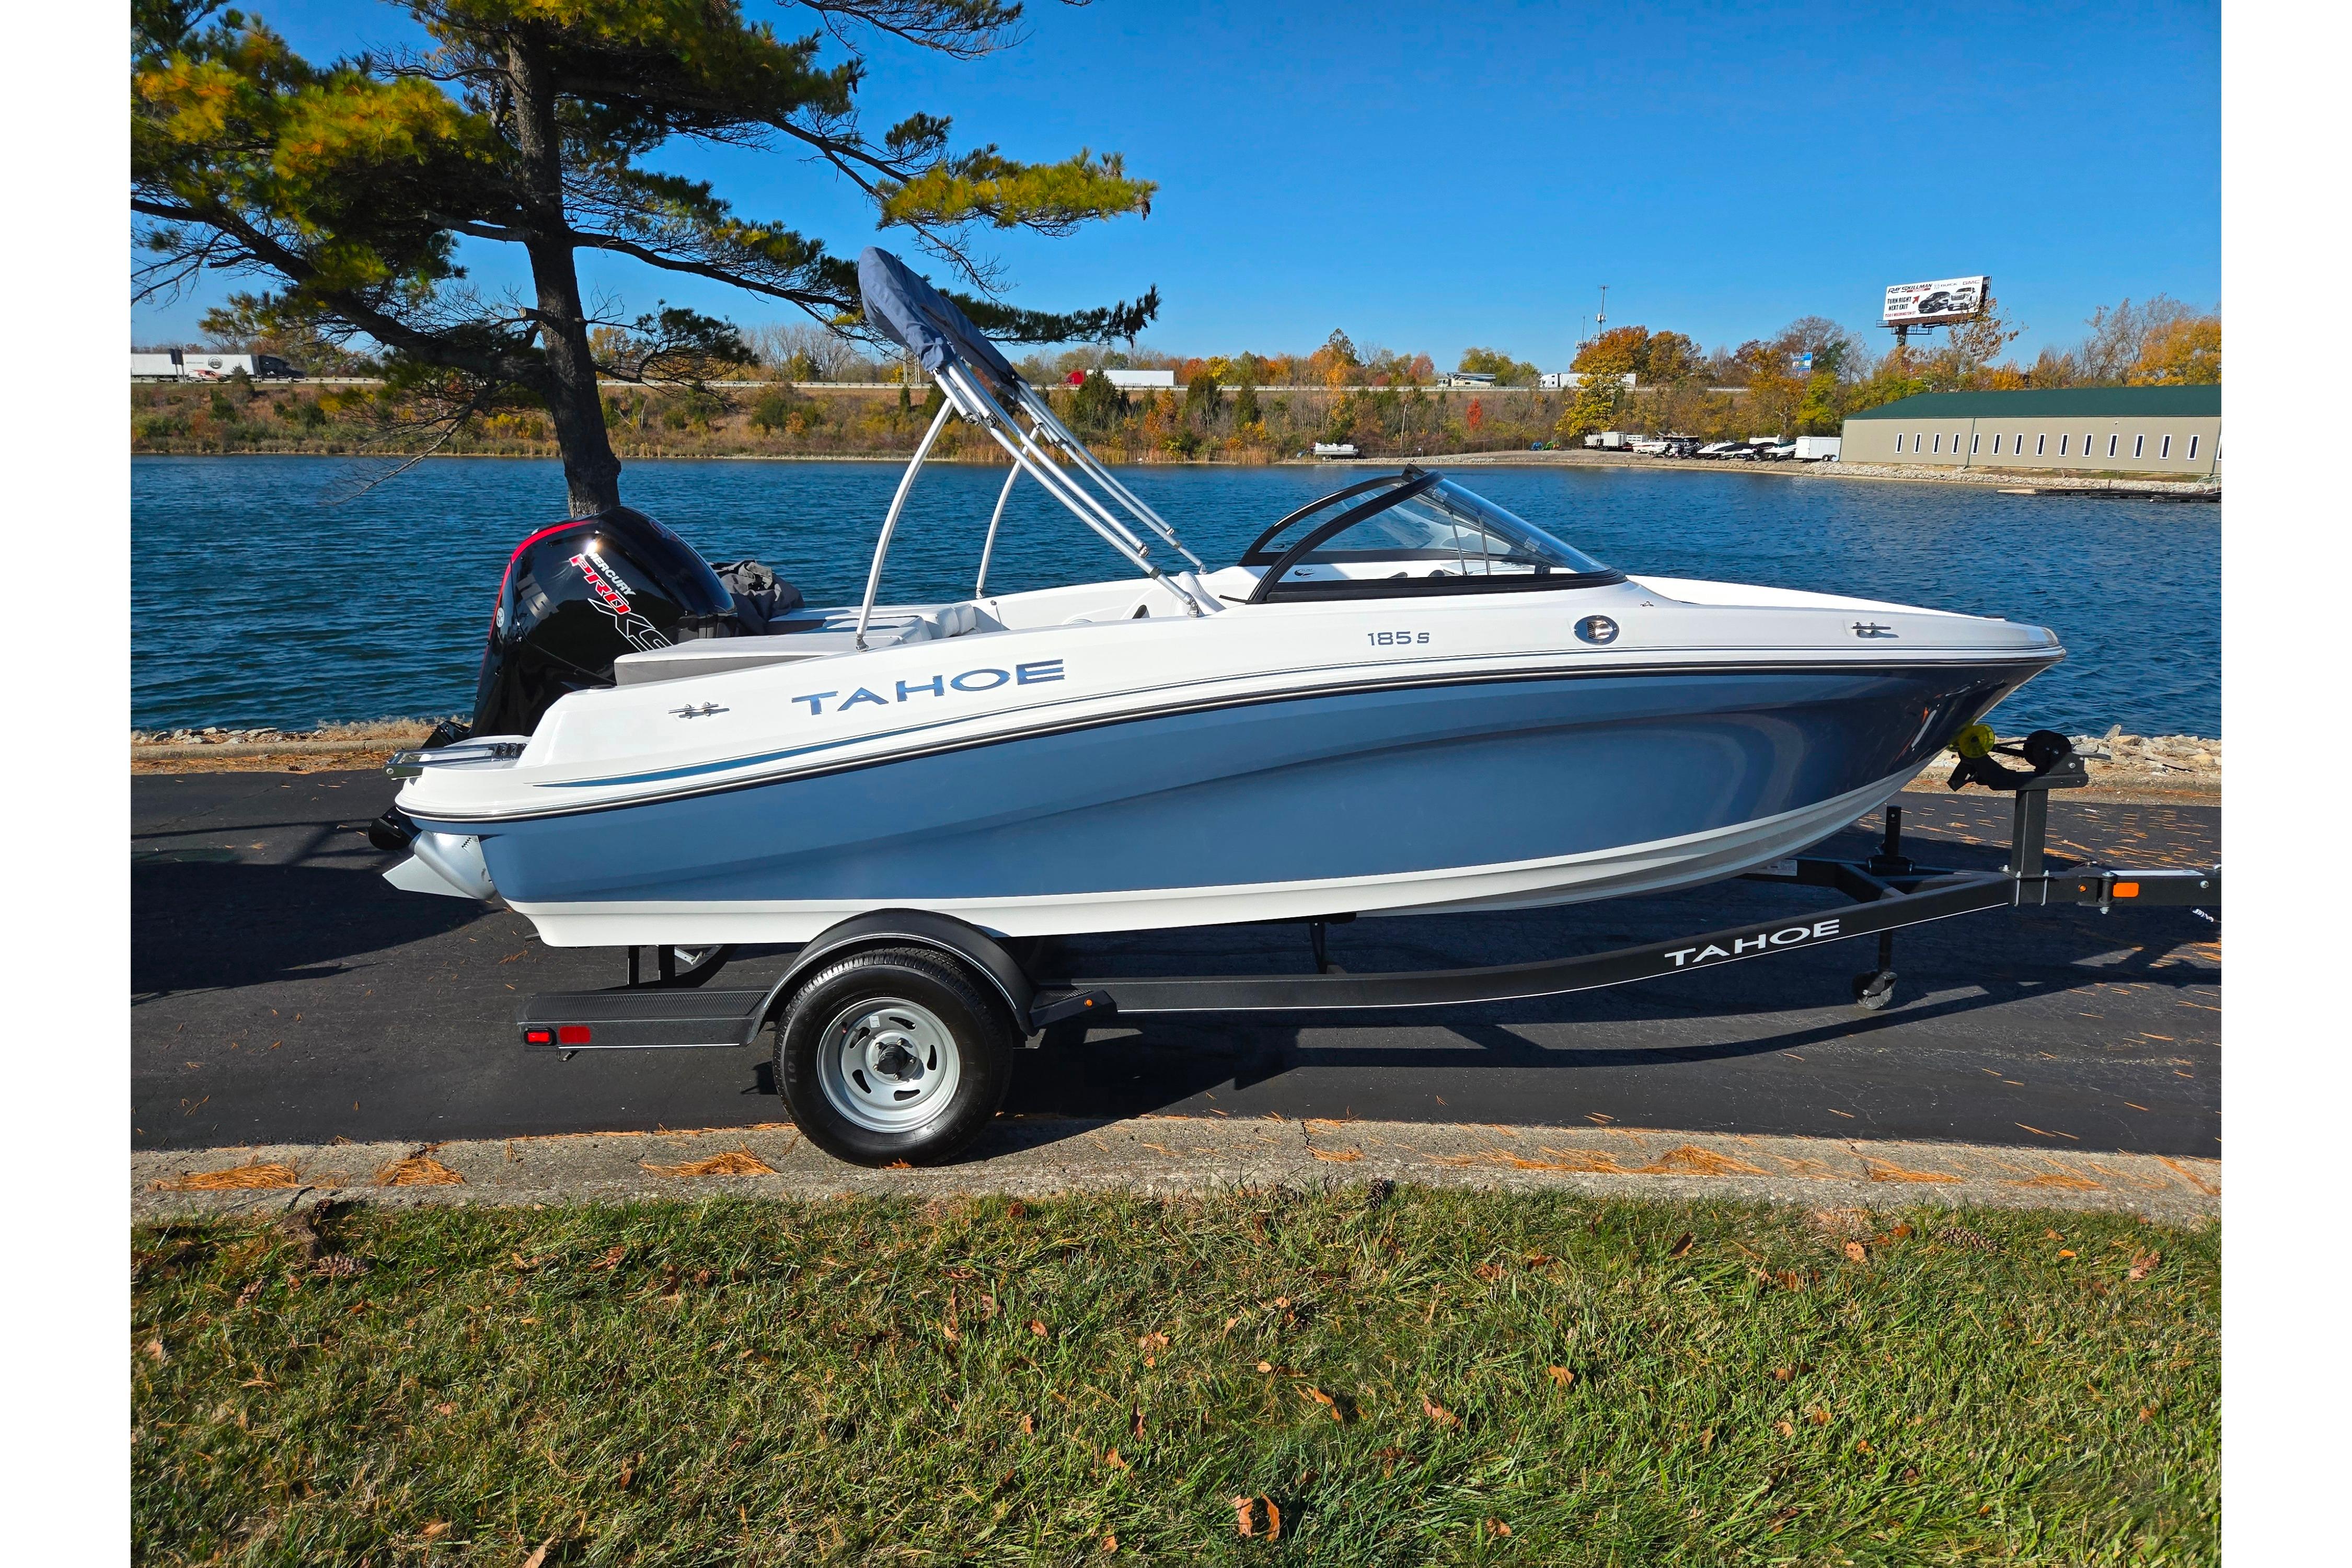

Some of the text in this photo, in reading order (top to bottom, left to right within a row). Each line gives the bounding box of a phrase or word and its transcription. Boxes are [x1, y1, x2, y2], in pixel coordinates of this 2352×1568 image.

[1901, 283, 1933, 292] SKILLMAN
[569, 554, 631, 615] PRO
[586, 551, 636, 595] MERCURY
[1367, 631, 1412, 646] 185
[791, 659, 1065, 716] TAHOE
[1664, 919, 1840, 966] TAHOE
